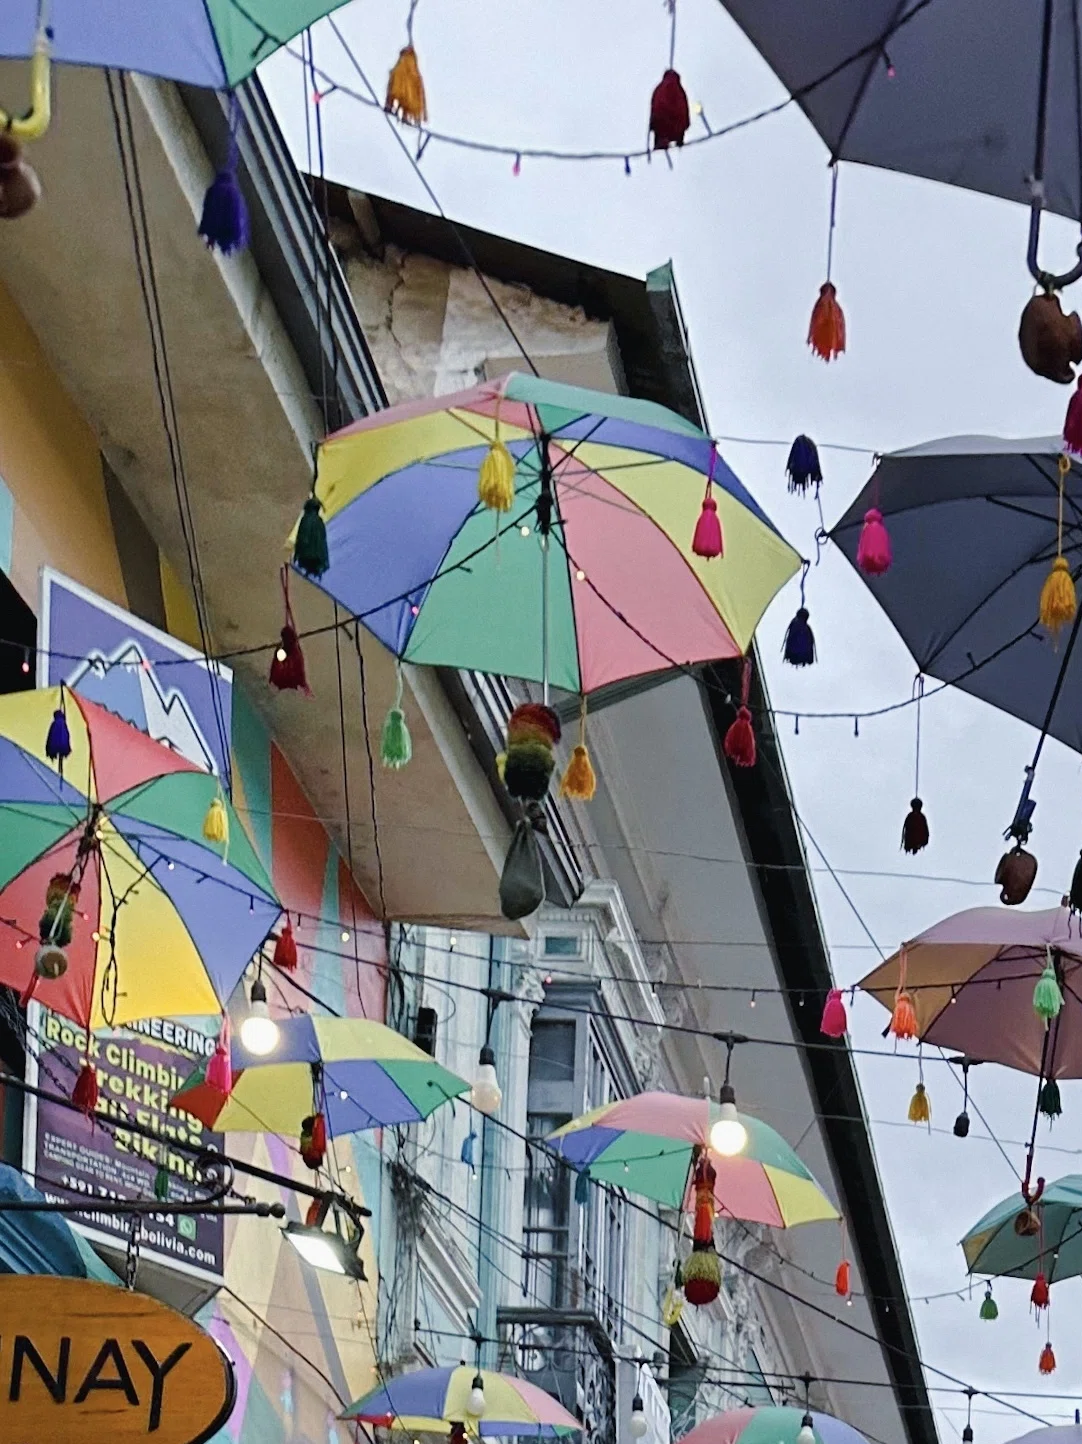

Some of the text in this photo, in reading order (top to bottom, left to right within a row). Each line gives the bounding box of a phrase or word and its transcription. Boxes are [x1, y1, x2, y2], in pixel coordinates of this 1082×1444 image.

[46, 1015, 185, 1092] Rock Climbi
[0, 1334, 193, 1433] NAY
